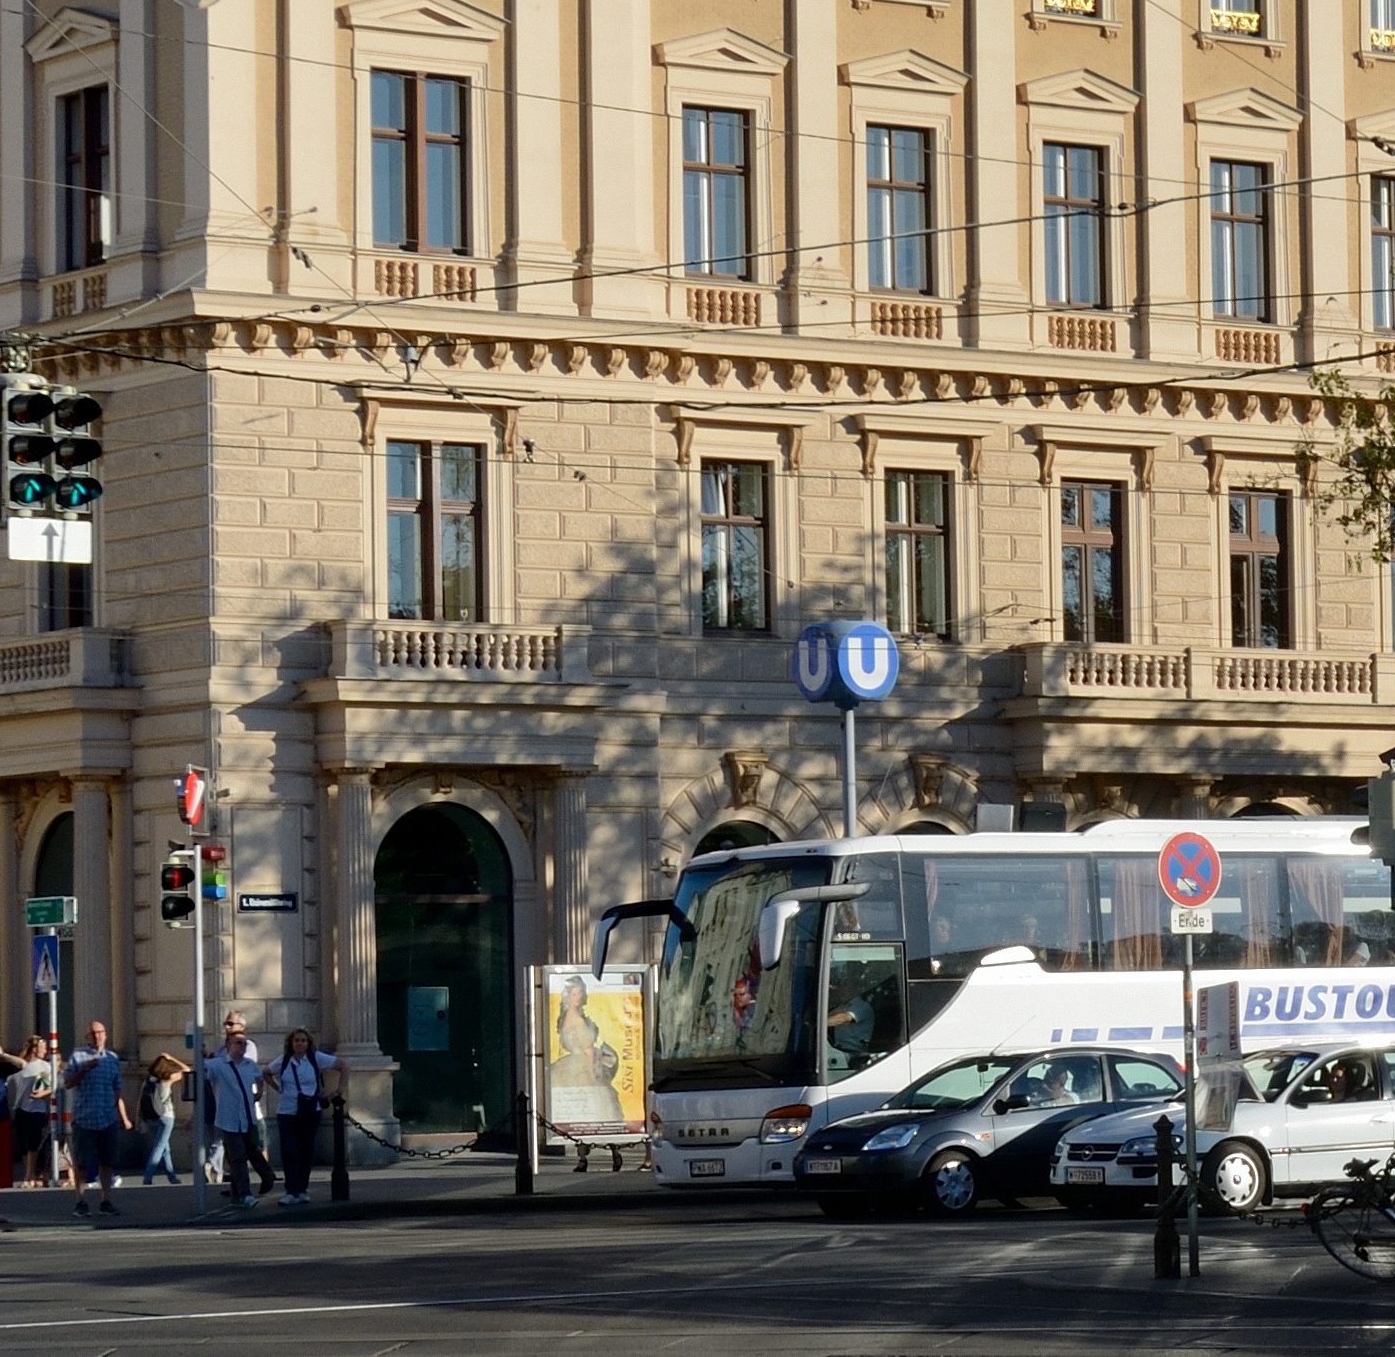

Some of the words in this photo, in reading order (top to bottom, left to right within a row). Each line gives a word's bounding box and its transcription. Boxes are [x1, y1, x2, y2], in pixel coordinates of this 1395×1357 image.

[798, 638, 827, 691] U
[847, 637, 889, 690] U
[1178, 913, 1205, 928] Ende
[621, 1065, 634, 1094] Sisi
[678, 1127, 730, 1138] SETRA
